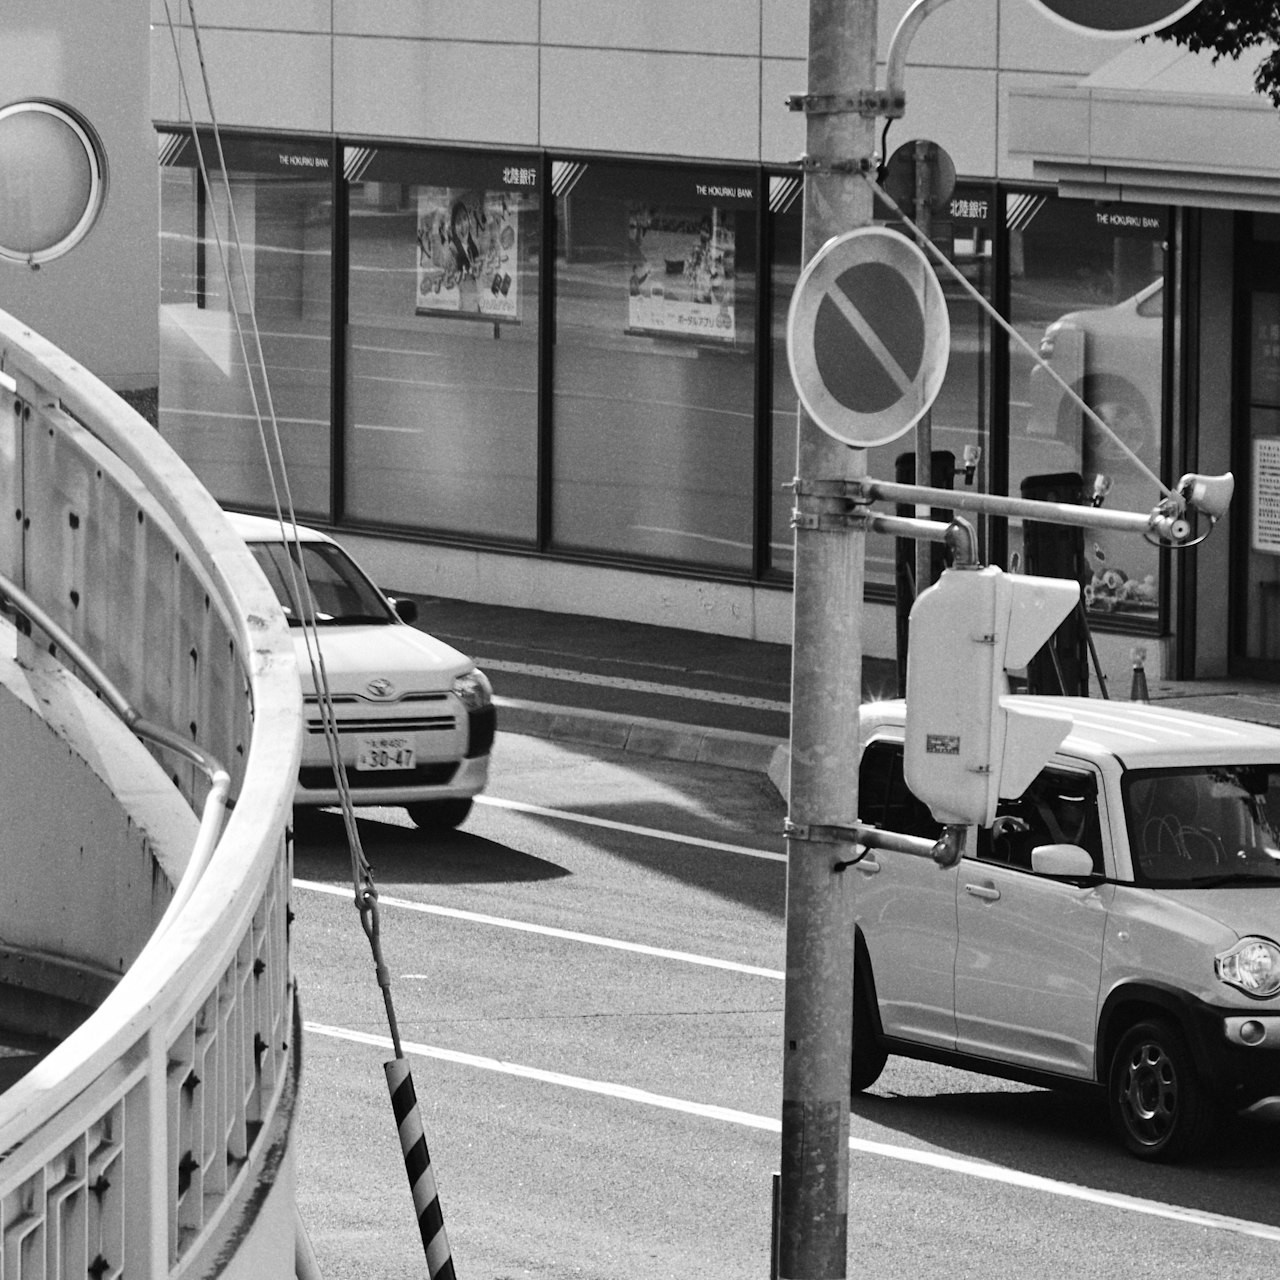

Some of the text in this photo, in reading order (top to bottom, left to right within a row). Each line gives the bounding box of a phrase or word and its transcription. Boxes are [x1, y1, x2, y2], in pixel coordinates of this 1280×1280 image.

[279, 155, 329, 167] THE HOKURIKU BANK
[503, 167, 536, 185] 北陸銀行
[696, 185, 753, 198] THE HOKURIKU BANK
[950, 200, 988, 218] 北陸銀行
[1096, 213, 1159, 228] THE HOKURIKU BANK
[369, 749, 413, 767] 30-47
